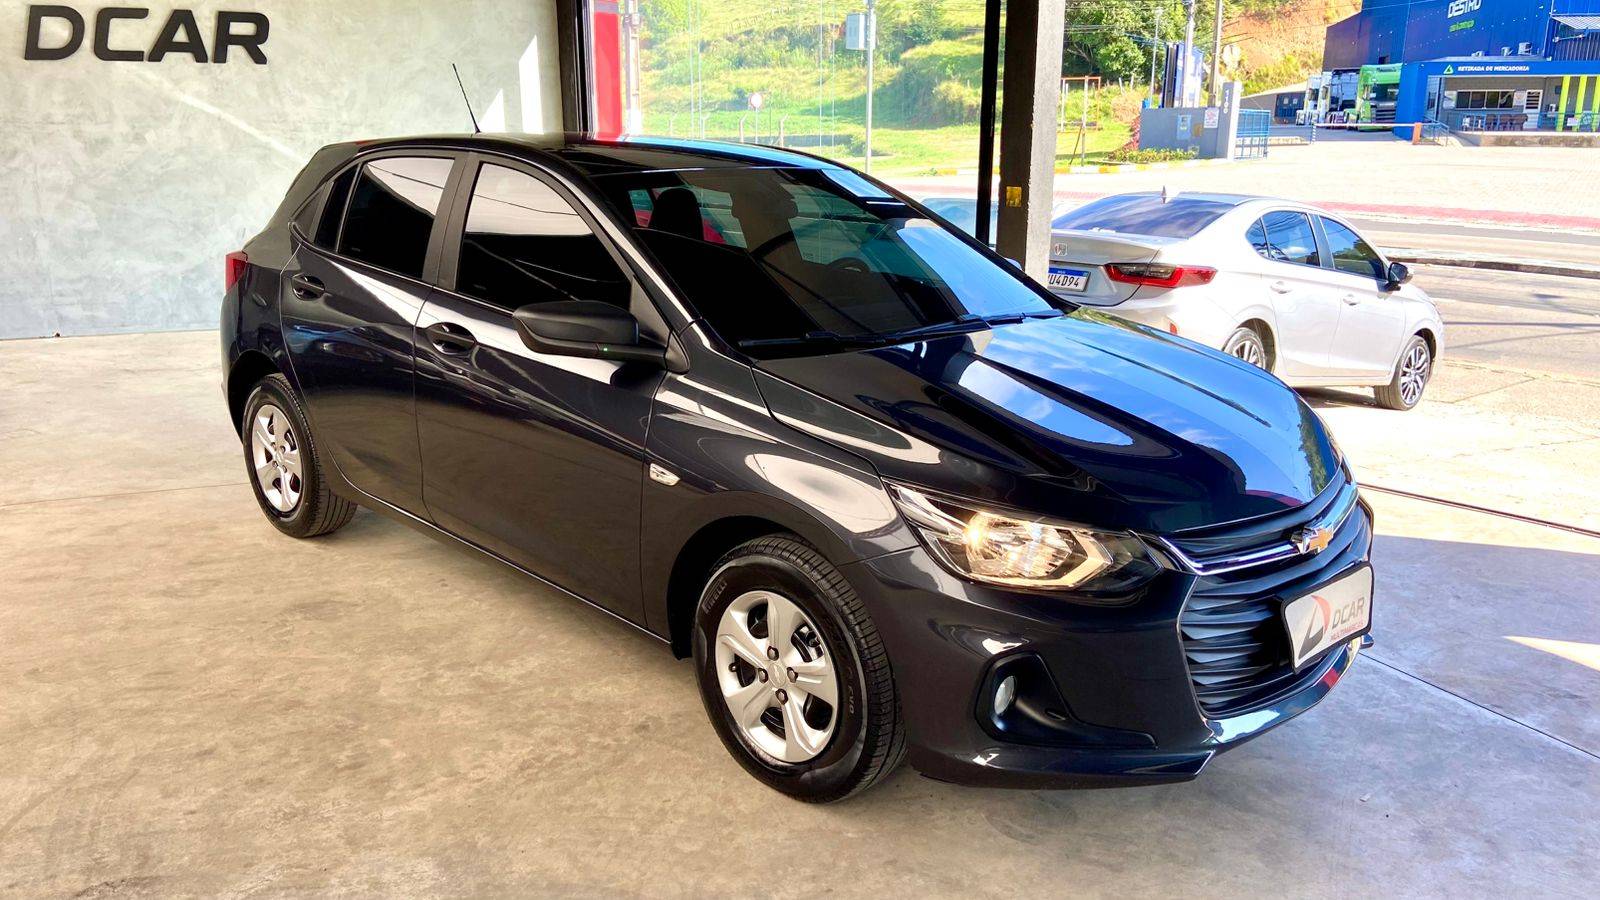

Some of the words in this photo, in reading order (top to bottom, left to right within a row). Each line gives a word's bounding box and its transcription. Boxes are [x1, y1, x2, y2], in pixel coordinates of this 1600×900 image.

[24, 4, 270, 65] DCAR
[1048, 274, 1080, 287] U4D94
[1332, 597, 1365, 629] DCAR
